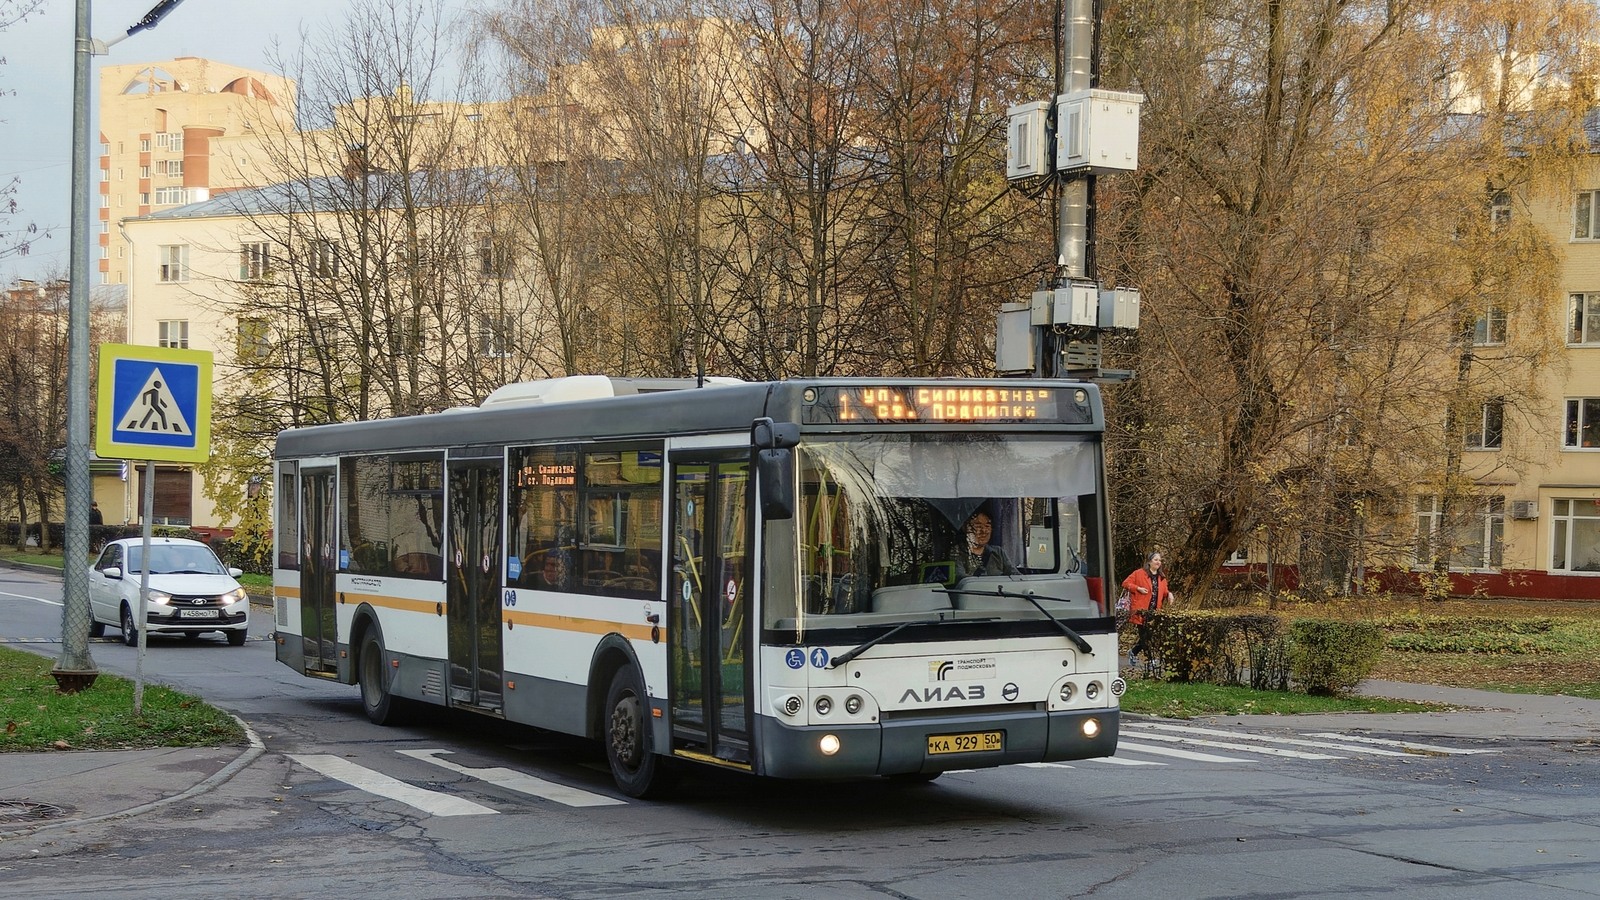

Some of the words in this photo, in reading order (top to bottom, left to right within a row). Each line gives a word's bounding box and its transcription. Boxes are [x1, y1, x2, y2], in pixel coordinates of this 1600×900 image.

[863, 389, 901, 404] ул.
[878, 404, 916, 418] ст.
[899, 685, 986, 703] ЛИАЗ
[935, 740, 950, 751] КА
[955, 736, 978, 750] 929
[984, 734, 996, 745] 50
